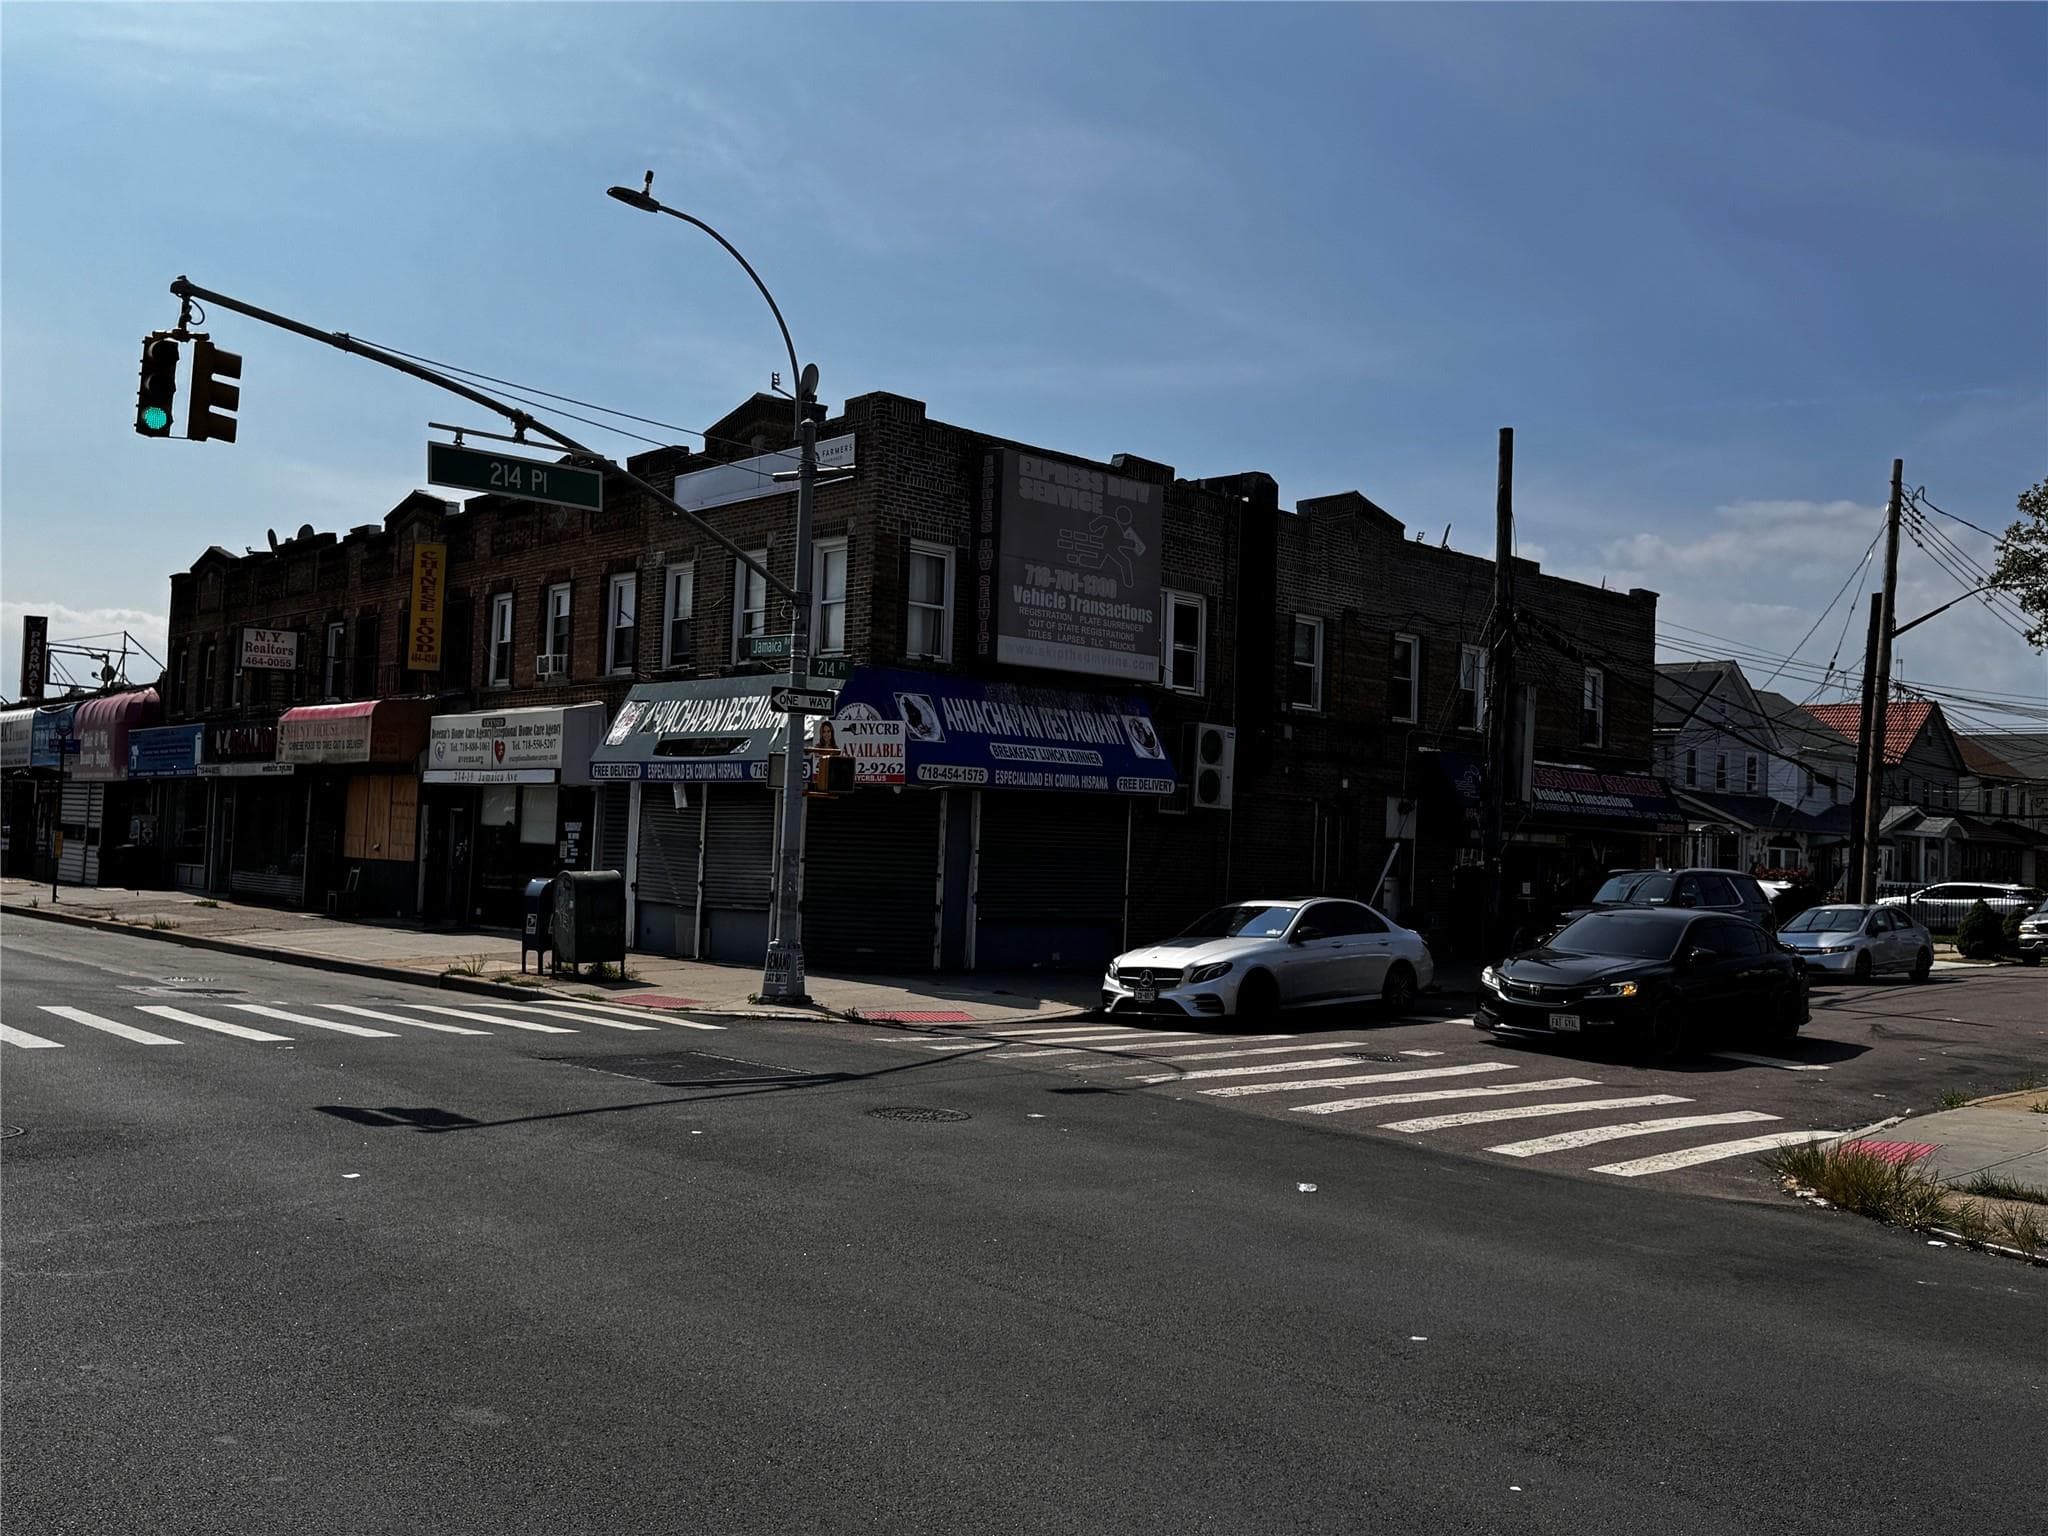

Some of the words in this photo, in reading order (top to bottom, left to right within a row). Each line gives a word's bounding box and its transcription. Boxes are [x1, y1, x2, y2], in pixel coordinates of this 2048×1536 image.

[823, 443, 852, 457] FARMERS
[489, 462, 522, 489] 214
[531, 469, 548, 494] Pl
[1018, 454, 1104, 493] EXPRESS
[1018, 477, 1103, 515] SERVICE
[420, 551, 438, 613] CHINESE
[1013, 584, 1066, 610] Vehicle
[1068, 594, 1153, 624] Transactions
[1018, 606, 1073, 622] REGISTRATION
[1079, 615, 1101, 626] PLATE
[1102, 617, 1144, 633] SURRENDER
[255, 631, 285, 643] N.Y.
[415, 617, 435, 653] FOOD
[1028, 618, 1045, 629] OUT
[1046, 620, 1057, 630] OF
[1057, 621, 1080, 633] STATE
[1081, 625, 1135, 641] REGISTRATIONS
[244, 641, 295, 656] Realtors
[753, 638, 782, 654] Jamaica
[1027, 629, 1052, 640] TITLES
[1057, 633, 1085, 645] LAPSES
[1090, 638, 1104, 648] TLC
[1109, 640, 1136, 651] TRUCKS
[29, 631, 42, 695] PHARMACY
[817, 660, 835, 676] 214
[780, 695, 799, 706] ONE
[808, 697, 832, 708] WAY
[859, 723, 900, 735] NYCRB
[941, 696, 1044, 739] AHUACHAPAN
[1040, 705, 1126, 746] RESTAURANT
[842, 743, 904, 758] AVAILABLE
[991, 744, 1037, 760] BREAKFAST
[1038, 747, 1067, 763] LUNCH
[478, 772, 504, 782] Jamaica
[505, 771, 518, 781] Ave
[594, 764, 608, 777] FREE
[610, 763, 640, 777] DELIVERY
[647, 763, 685, 780] ESPECIALIDAD
[686, 763, 694, 779] EN
[694, 763, 717, 779] COMIDA
[718, 763, 743, 779] HISPANA
[921, 766, 985, 781] 718-454-1575
[995, 769, 1042, 788] ESPECIALIDAD
[1043, 774, 1054, 788] EN
[1055, 774, 1080, 789] COMIDA
[1081, 776, 1109, 791] HISPANA
[1119, 778, 1138, 790] FREE
[1138, 779, 1172, 793] DELIVERY
[1533, 787, 1573, 803] Vehicle
[1574, 791, 1634, 809] Transactions
